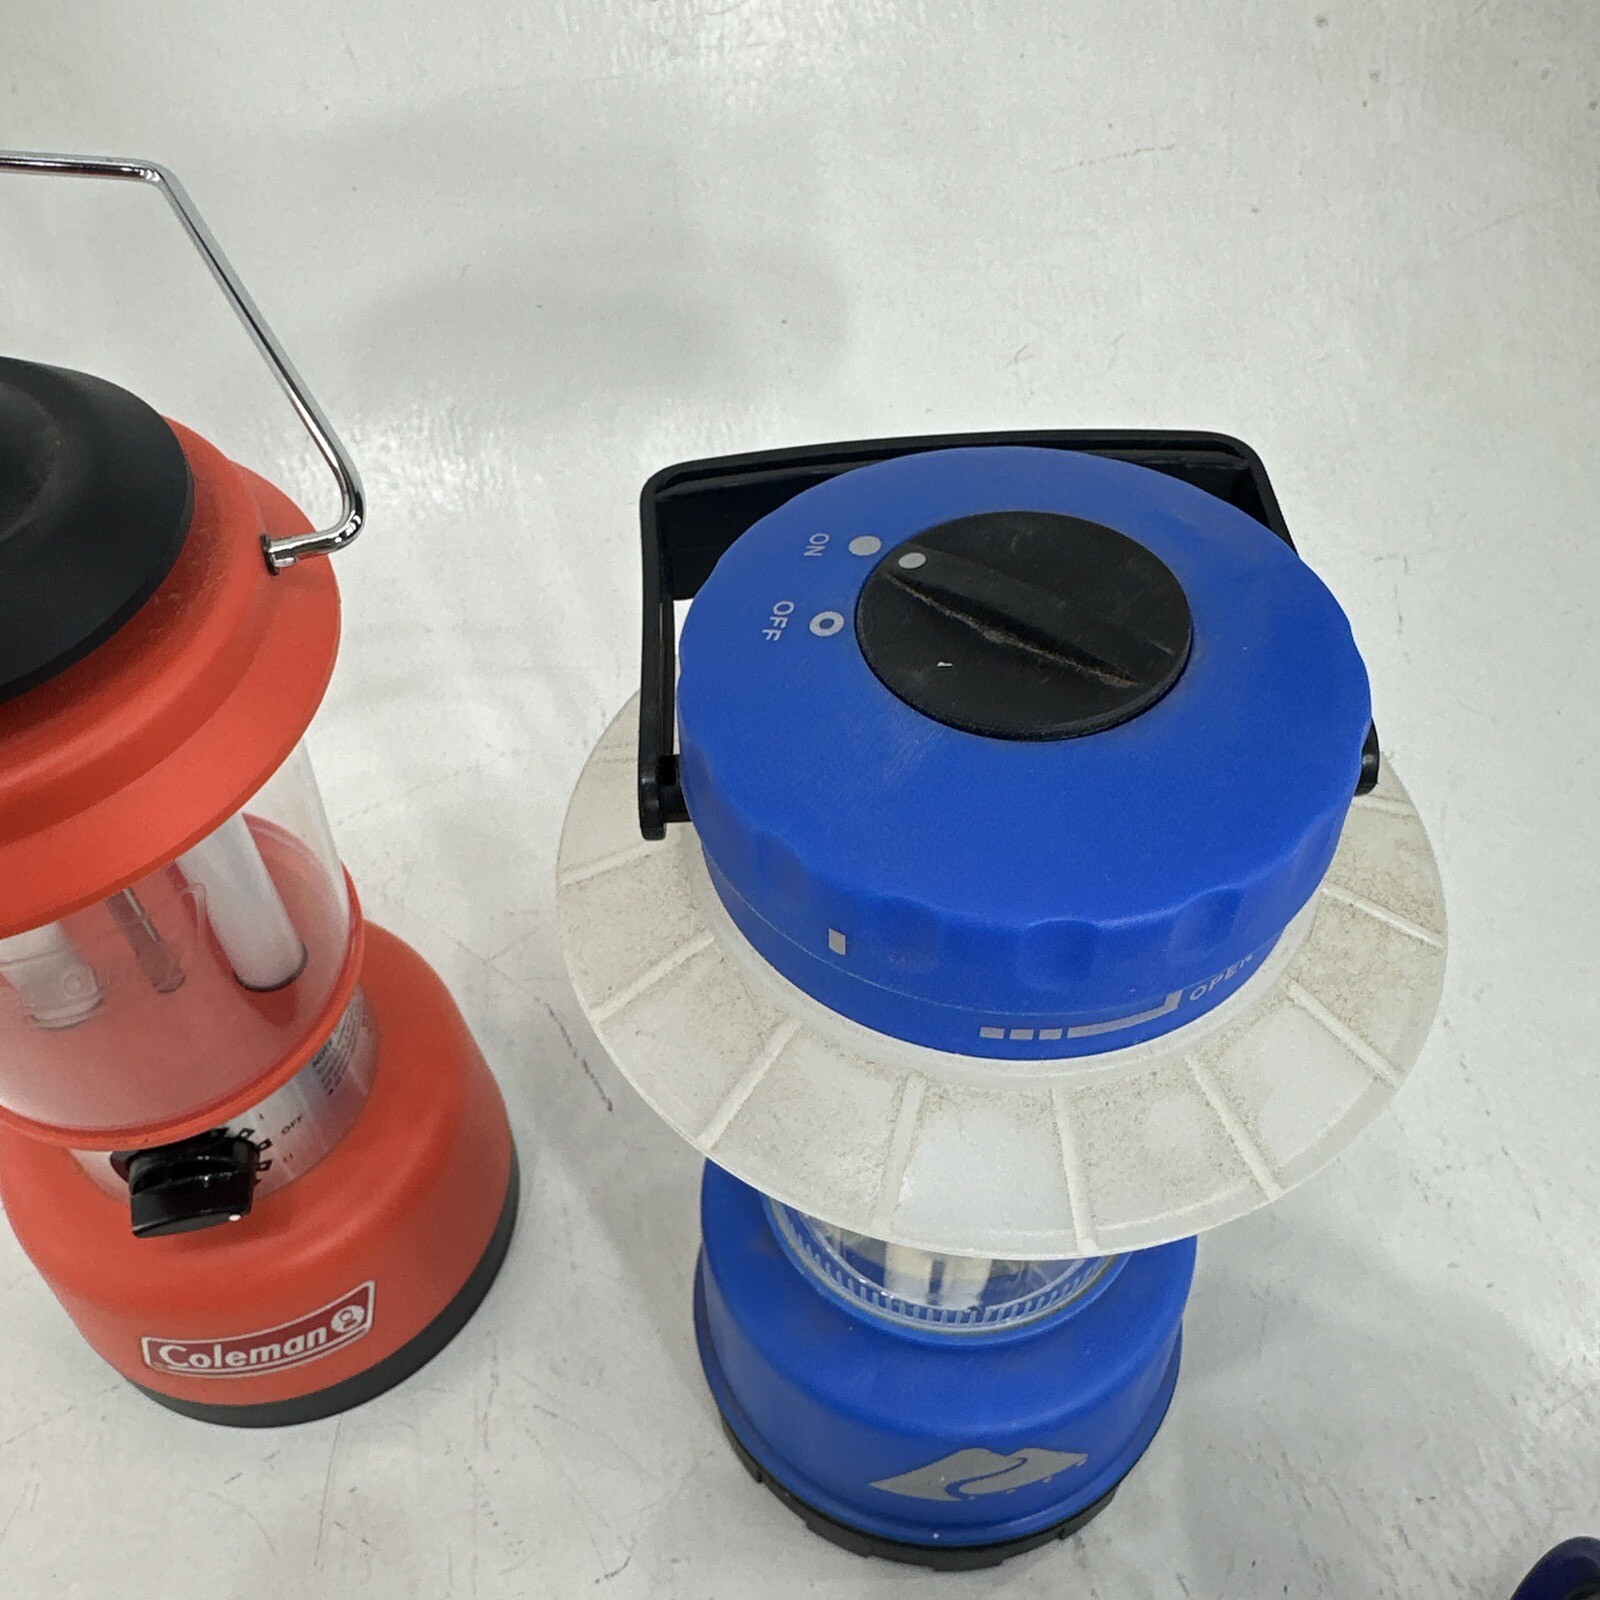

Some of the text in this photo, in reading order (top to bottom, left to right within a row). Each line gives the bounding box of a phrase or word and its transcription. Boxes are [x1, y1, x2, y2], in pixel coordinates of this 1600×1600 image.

[803, 533, 830, 557] ON
[762, 600, 795, 641] OFF
[281, 1113, 303, 1135] OFF
[158, 1325, 328, 1369] Coleman
